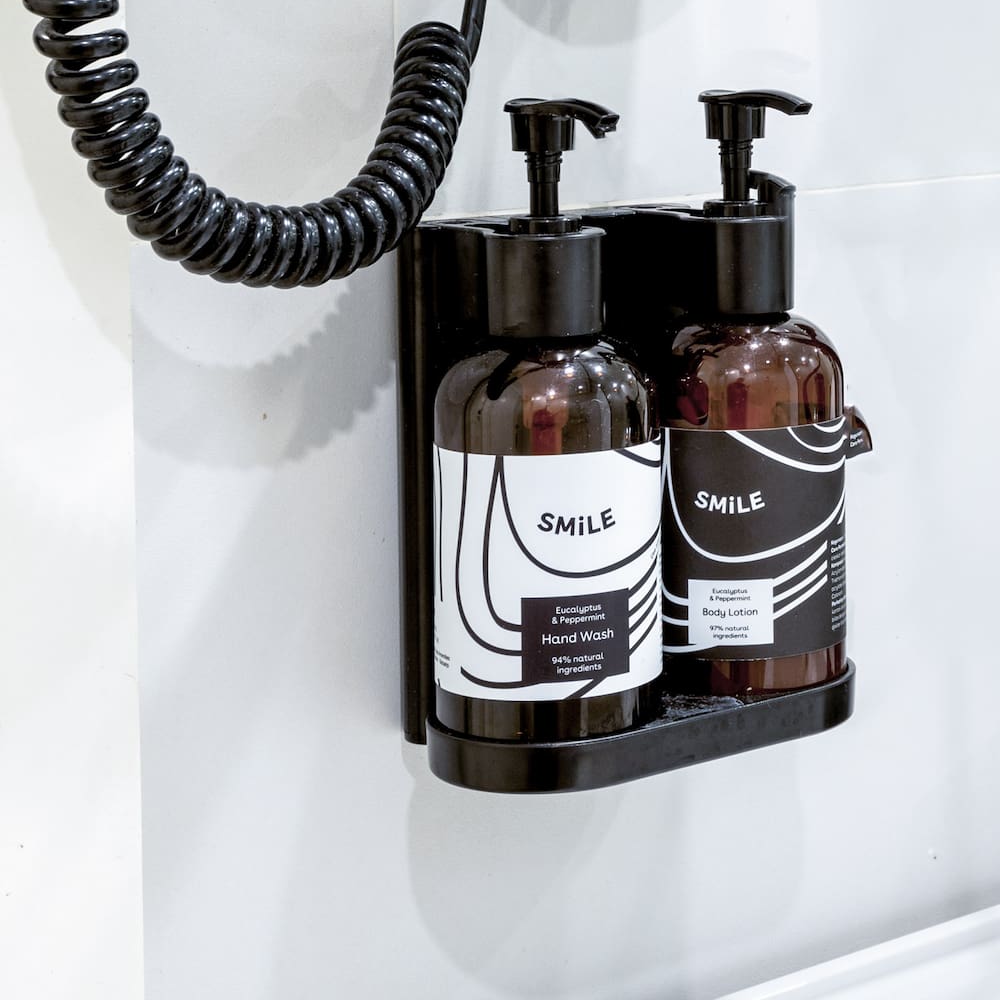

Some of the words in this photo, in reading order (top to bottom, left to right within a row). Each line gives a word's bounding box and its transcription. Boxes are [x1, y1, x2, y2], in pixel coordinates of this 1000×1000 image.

[694, 490, 765, 515] SMiLE
[536, 507, 616, 536] SMiLE
[555, 604, 602, 615] Eucalyptus
[702, 607, 726, 619] Body
[728, 607, 758, 617] Lotion
[551, 616, 558, 625] &
[560, 613, 605, 624] Peppermint
[541, 632, 577, 645] Hand
[579, 628, 614, 642] Wash
[713, 632, 748, 640] ingredients
[551, 655, 571, 664] 94%
[572, 652, 604, 663] natural
[556, 663, 602, 675] ingredients
